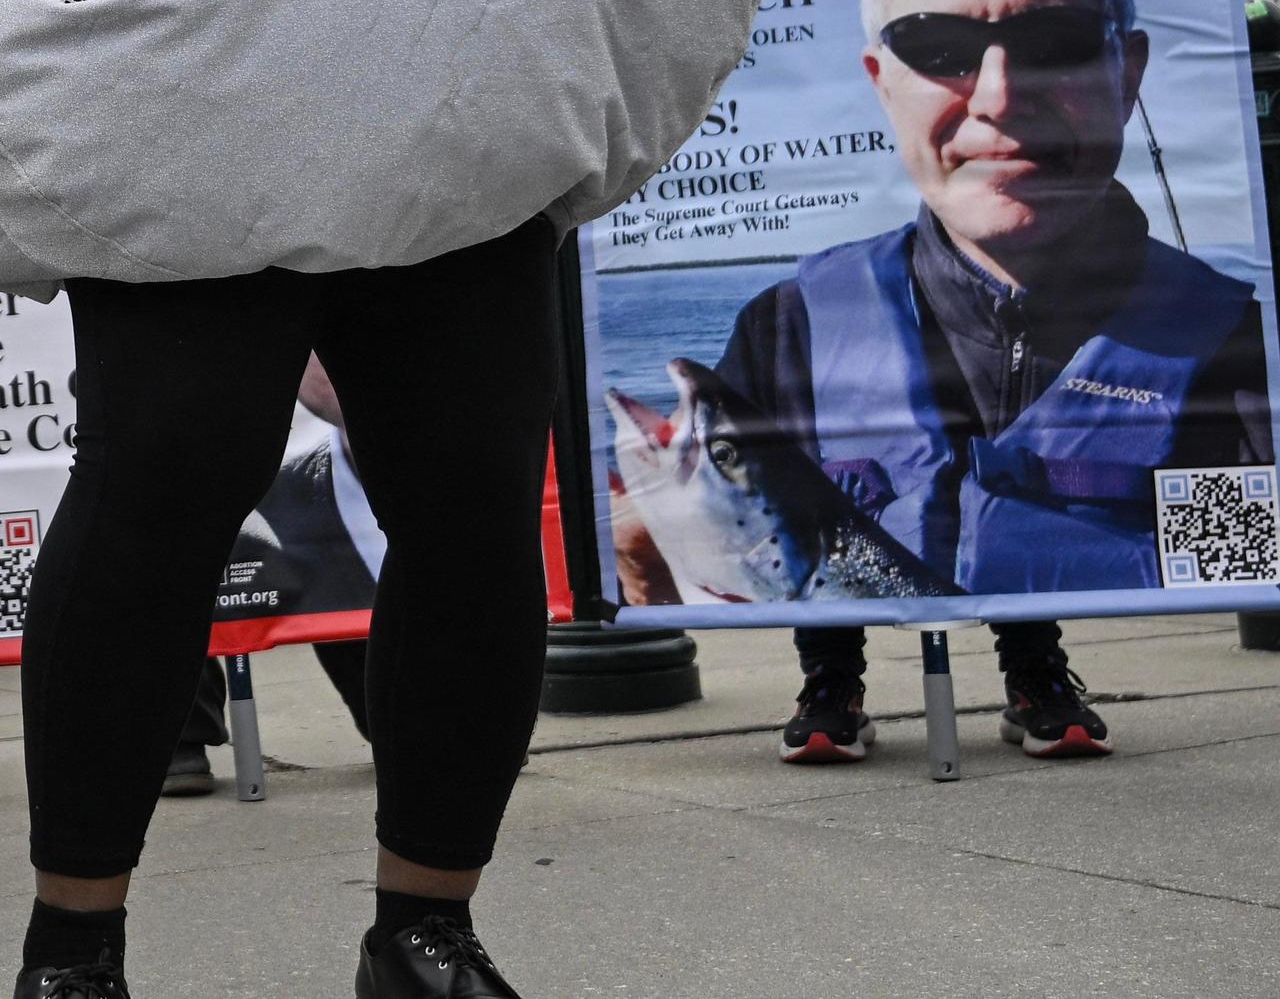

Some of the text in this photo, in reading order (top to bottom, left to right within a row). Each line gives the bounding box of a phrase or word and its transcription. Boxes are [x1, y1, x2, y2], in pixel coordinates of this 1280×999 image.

[752, 24, 815, 46] OLEN
[740, 142, 777, 165] OF
[784, 131, 895, 160] WATER,
[658, 170, 766, 201] CHOICE
[609, 190, 859, 228] The Supreme Court Getaways
[609, 214, 791, 248] They Get Away With!
